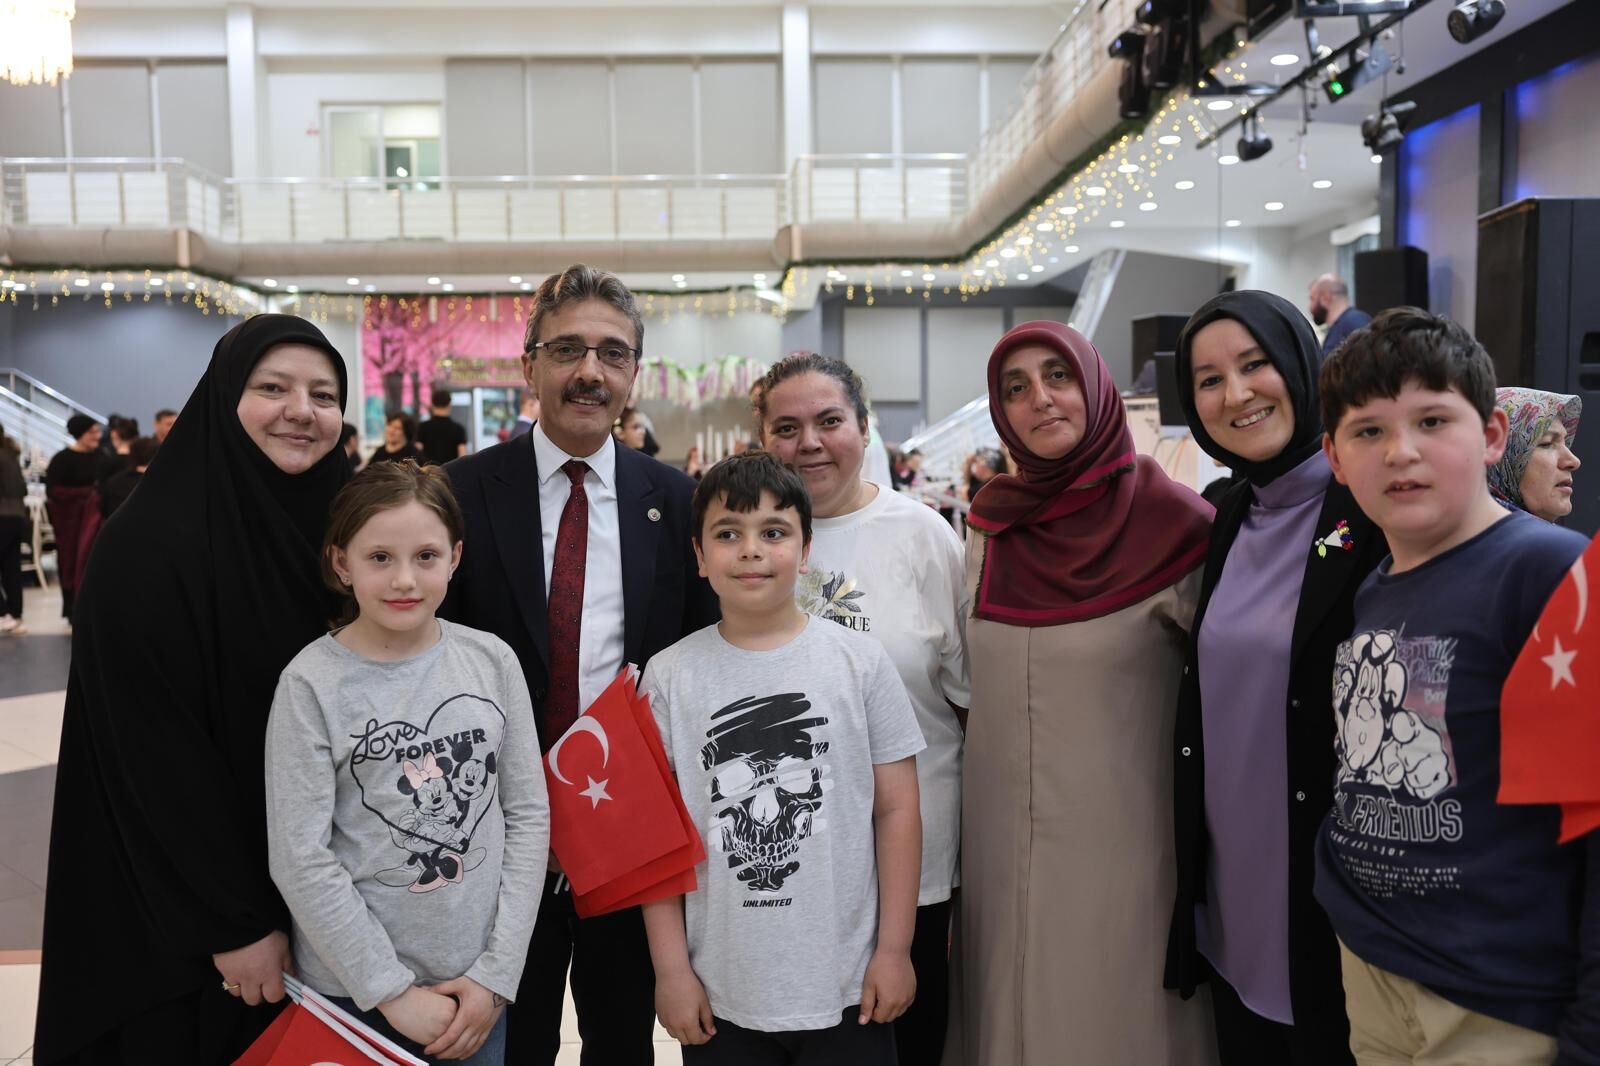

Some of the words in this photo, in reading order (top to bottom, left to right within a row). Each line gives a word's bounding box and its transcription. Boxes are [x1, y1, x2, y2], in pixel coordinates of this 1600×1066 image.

[350, 718, 418, 765] Love
[394, 728, 487, 763] FOREVER
[742, 897, 793, 908] UNLIMITED
